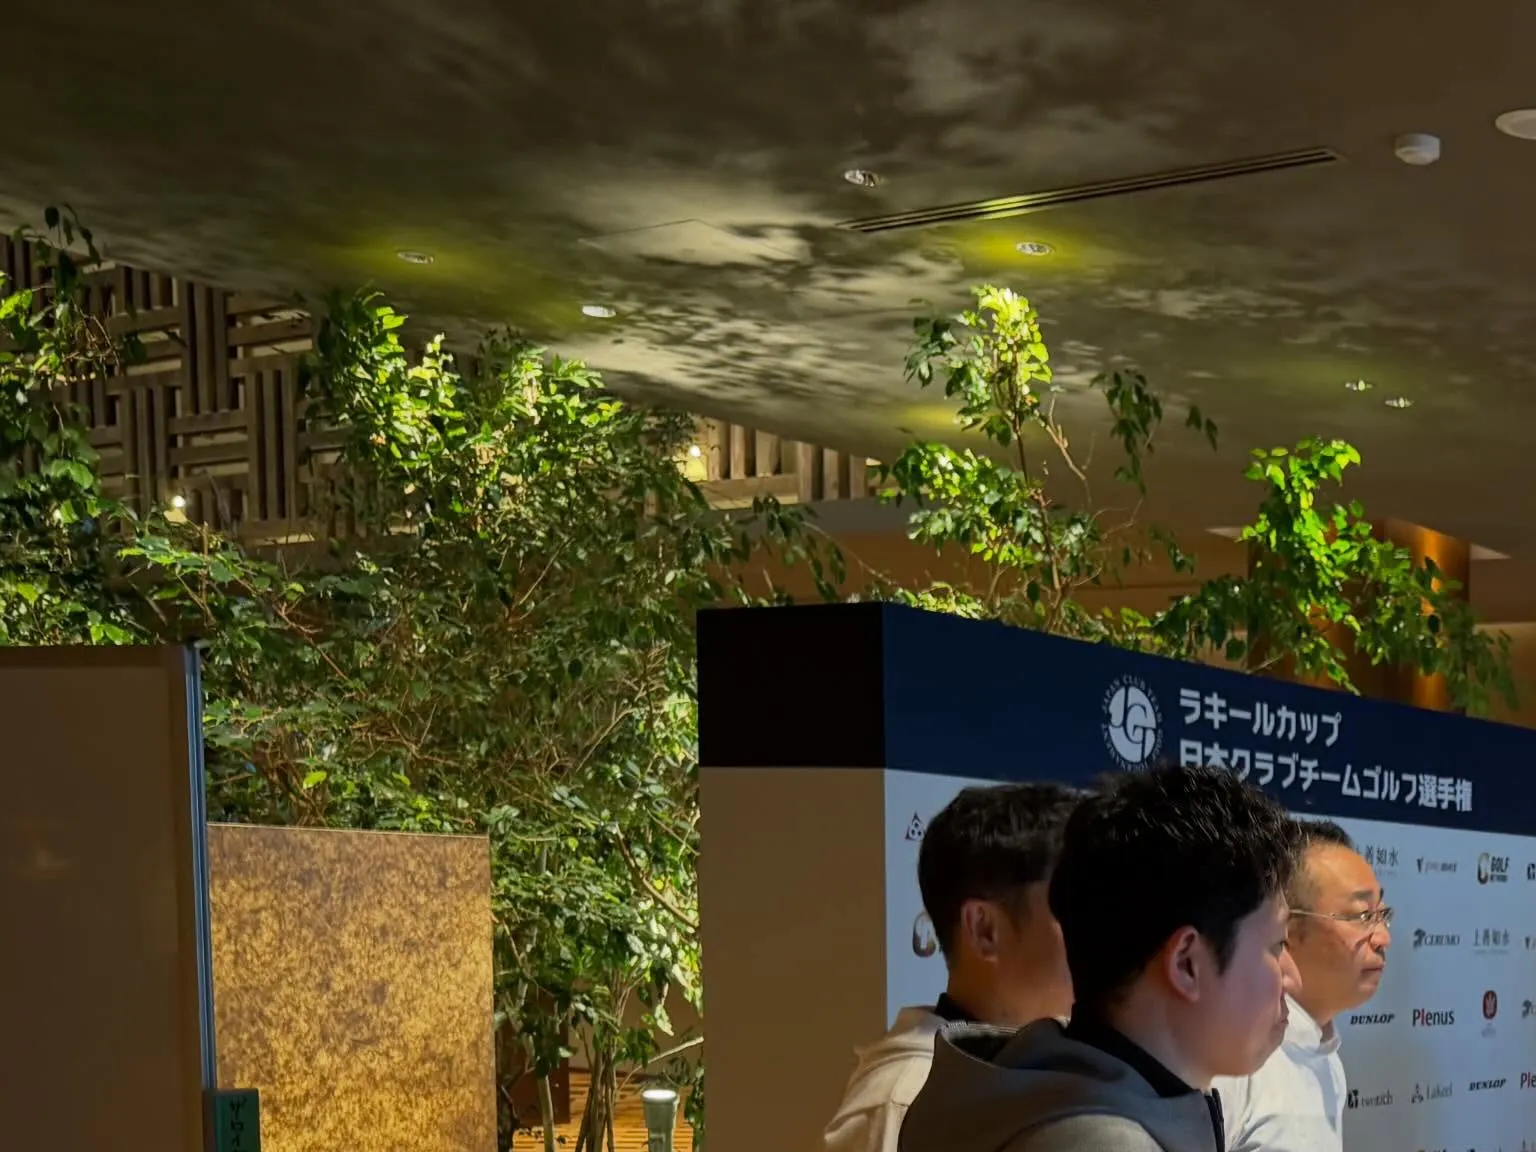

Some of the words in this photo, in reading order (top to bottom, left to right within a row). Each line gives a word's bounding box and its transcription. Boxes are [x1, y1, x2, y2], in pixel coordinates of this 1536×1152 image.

[1179, 688, 1341, 747] ラキールカップ
[1179, 739, 1473, 812] 日本クラブチームゴルフ選手権
[1350, 1013, 1395, 1025] DUNLOP
[1412, 1008, 1455, 1027] Plenus
[1469, 1079, 1507, 1091] DUNLOP
